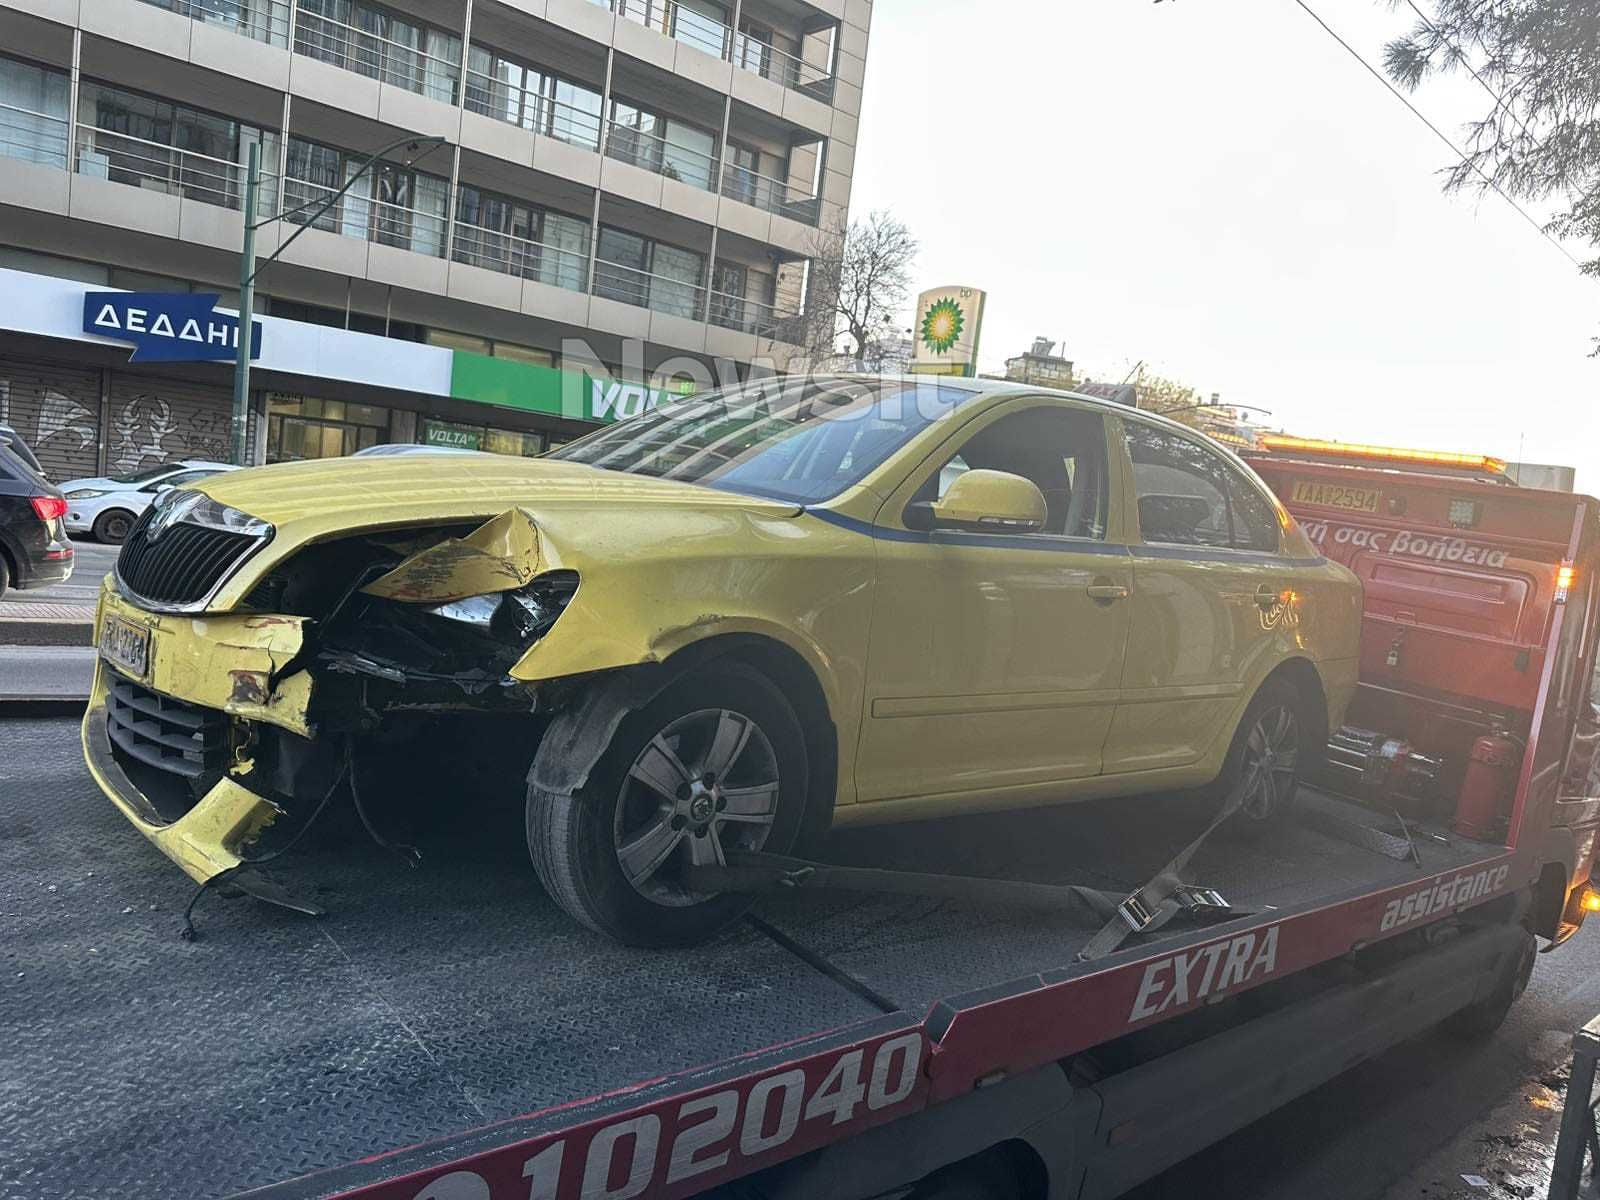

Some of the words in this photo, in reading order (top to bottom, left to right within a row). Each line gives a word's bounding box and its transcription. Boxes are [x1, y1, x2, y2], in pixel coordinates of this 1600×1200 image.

[428, 428, 468, 445] VOLTA
[1334, 527, 1387, 553] σας
[1389, 530, 1510, 569] βοήθεια
[1127, 926, 1281, 1024] EXTRA
[1380, 863, 1510, 932] assistance
